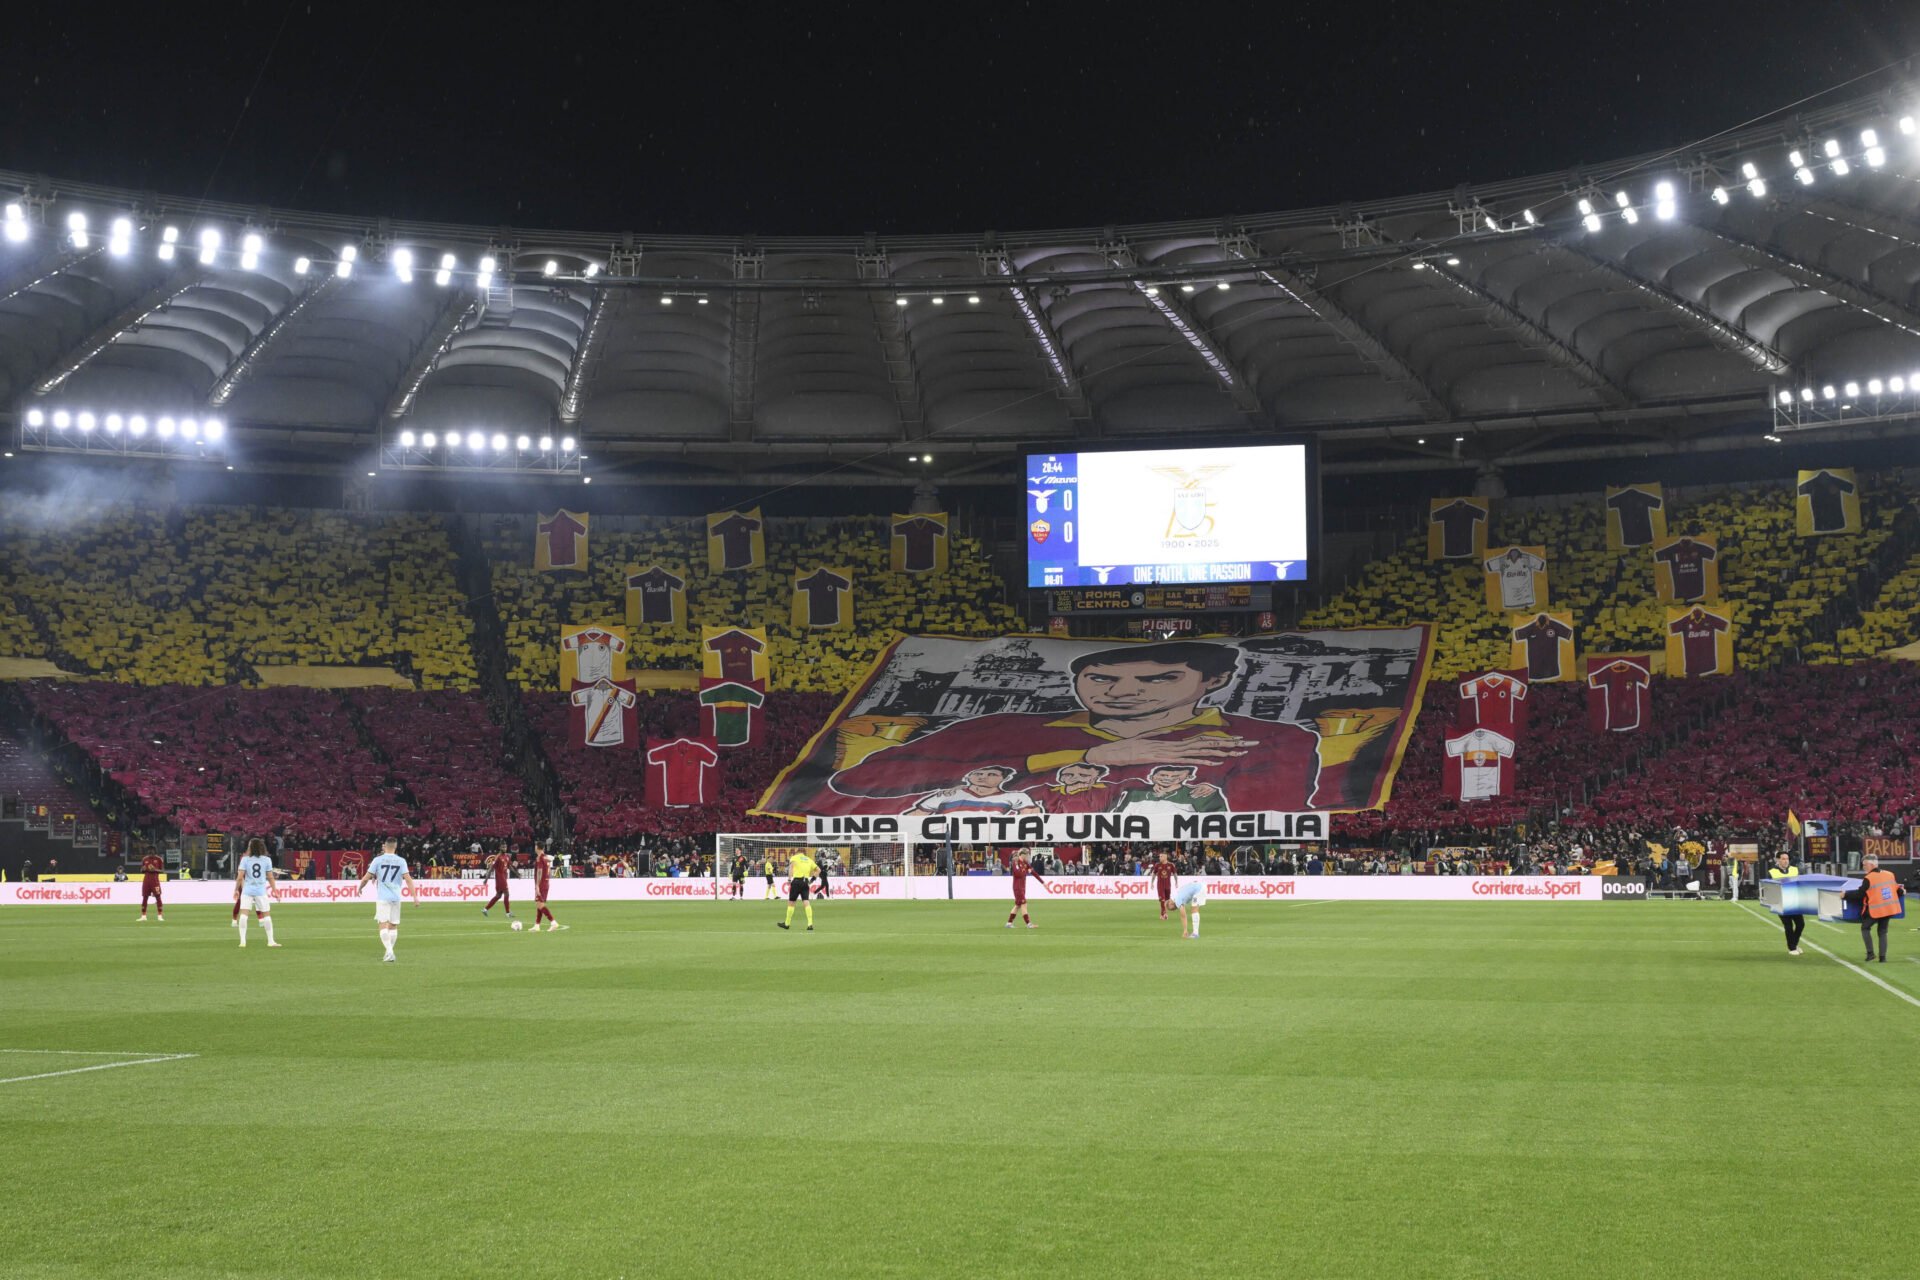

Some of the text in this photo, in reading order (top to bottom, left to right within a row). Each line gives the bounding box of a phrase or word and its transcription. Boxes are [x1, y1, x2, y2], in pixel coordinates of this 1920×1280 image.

[1064, 490, 1072, 511] 0
[1064, 521, 1073, 543] 0
[1133, 566, 1153, 582] ONE
[1187, 564, 1208, 581] ONE
[1210, 563, 1251, 580] PASSION
[1085, 591, 1121, 599] ROMA
[1077, 600, 1130, 608] CENTRO
[1142, 618, 1192, 630] PIGNETO
[1261, 620, 1272, 628] AS
[814, 817, 899, 841] UNA
[1066, 814, 1149, 840] UNA
[1173, 813, 1322, 839] MAGLIA
[1865, 839, 1906, 856] PARIGI
[252, 863, 261, 878] 8
[381, 864, 400, 882] 77
[16, 887, 111, 903] Corriere dello Sport
[310, 889, 326, 897] dello
[326, 885, 358, 901] Sport
[440, 888, 457, 897] dello
[457, 884, 489, 900] Sport
[646, 882, 692, 895] Corriere
[693, 886, 710, 895] dello
[847, 881, 880, 898] Sport
[1047, 881, 1149, 898] Corriere dello Sport
[1241, 885, 1259, 894] dello
[1260, 881, 1295, 898] Sport
[1472, 881, 1581, 899] Corriere dello Sport
[1603, 882, 1645, 895] 00:00
